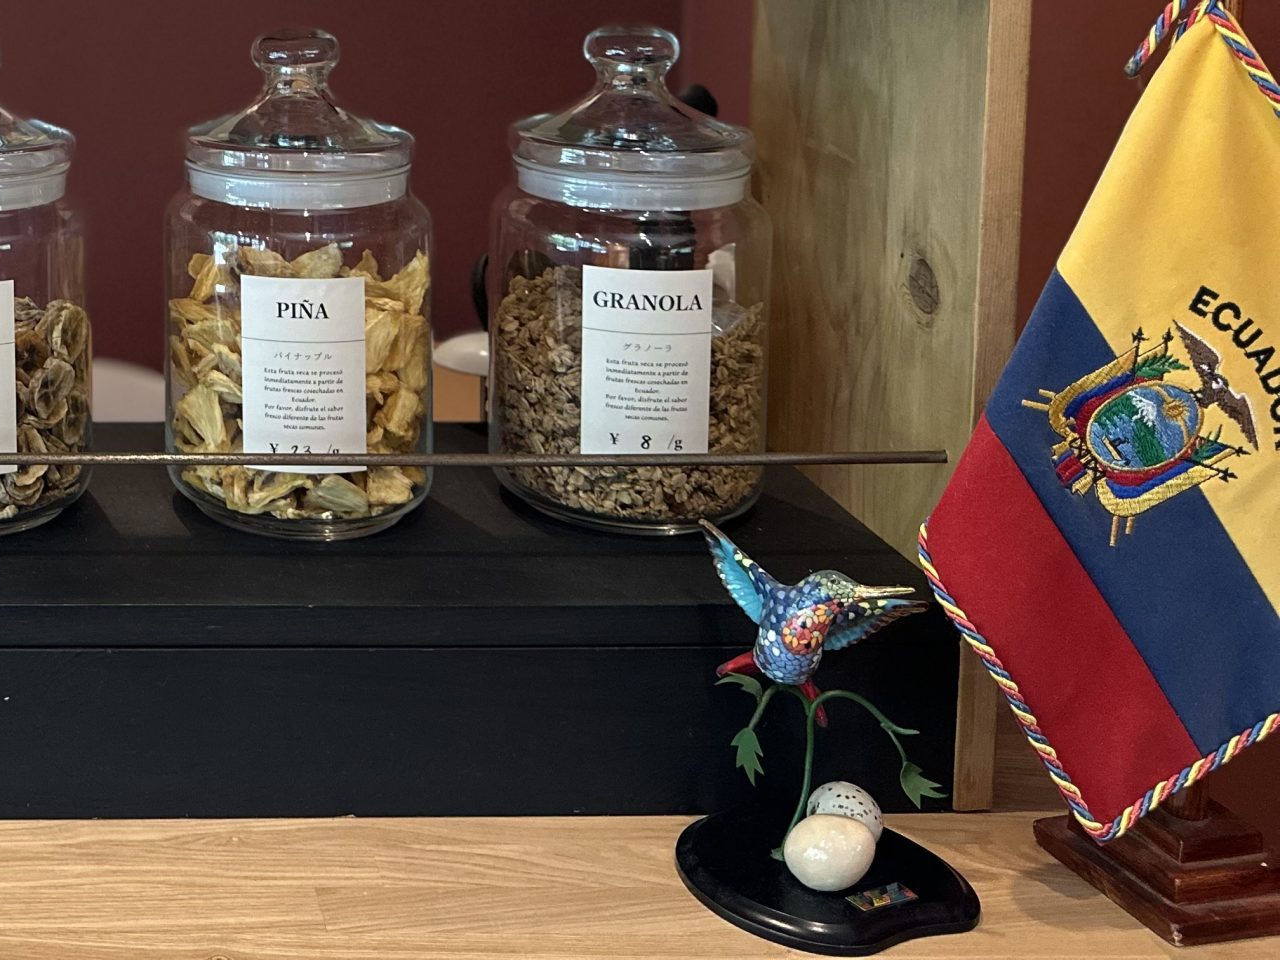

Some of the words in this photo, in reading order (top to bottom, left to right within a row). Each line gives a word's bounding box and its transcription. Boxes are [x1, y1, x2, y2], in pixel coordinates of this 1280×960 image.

[278, 300, 329, 319] PIÑA
[593, 292, 703, 311] GRANOLA
[624, 343, 673, 352] グラノーラ
[641, 435, 652, 449] 8
